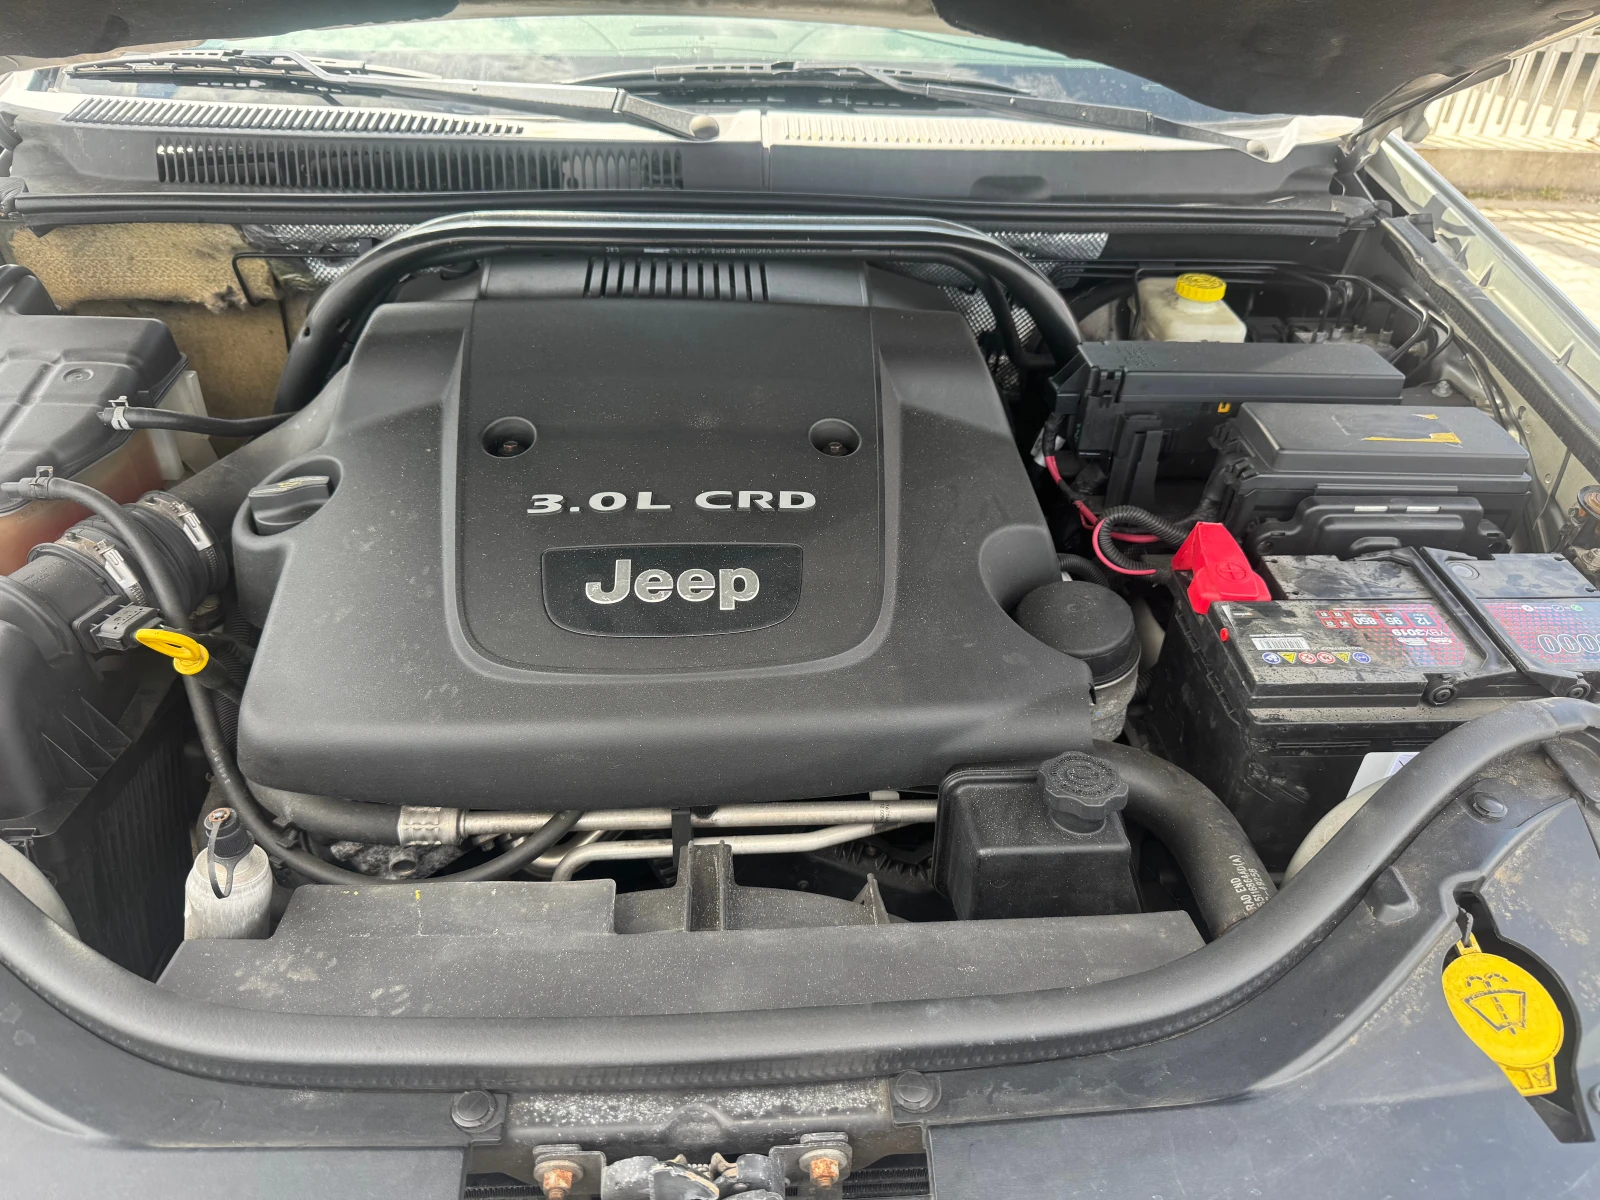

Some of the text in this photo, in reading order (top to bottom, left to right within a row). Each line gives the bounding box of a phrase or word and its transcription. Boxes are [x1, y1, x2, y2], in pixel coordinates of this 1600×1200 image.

[527, 490, 816, 514] 3.0L CRD
[585, 559, 760, 611] Jeep
[1352, 616, 1378, 625] 850
[1385, 616, 1404, 625] 95
[1414, 617, 1433, 626] 12
[1391, 628, 1448, 637] YBX3019
[1537, 633, 1600, 654] 000
[1230, 877, 1257, 911] RAD END
